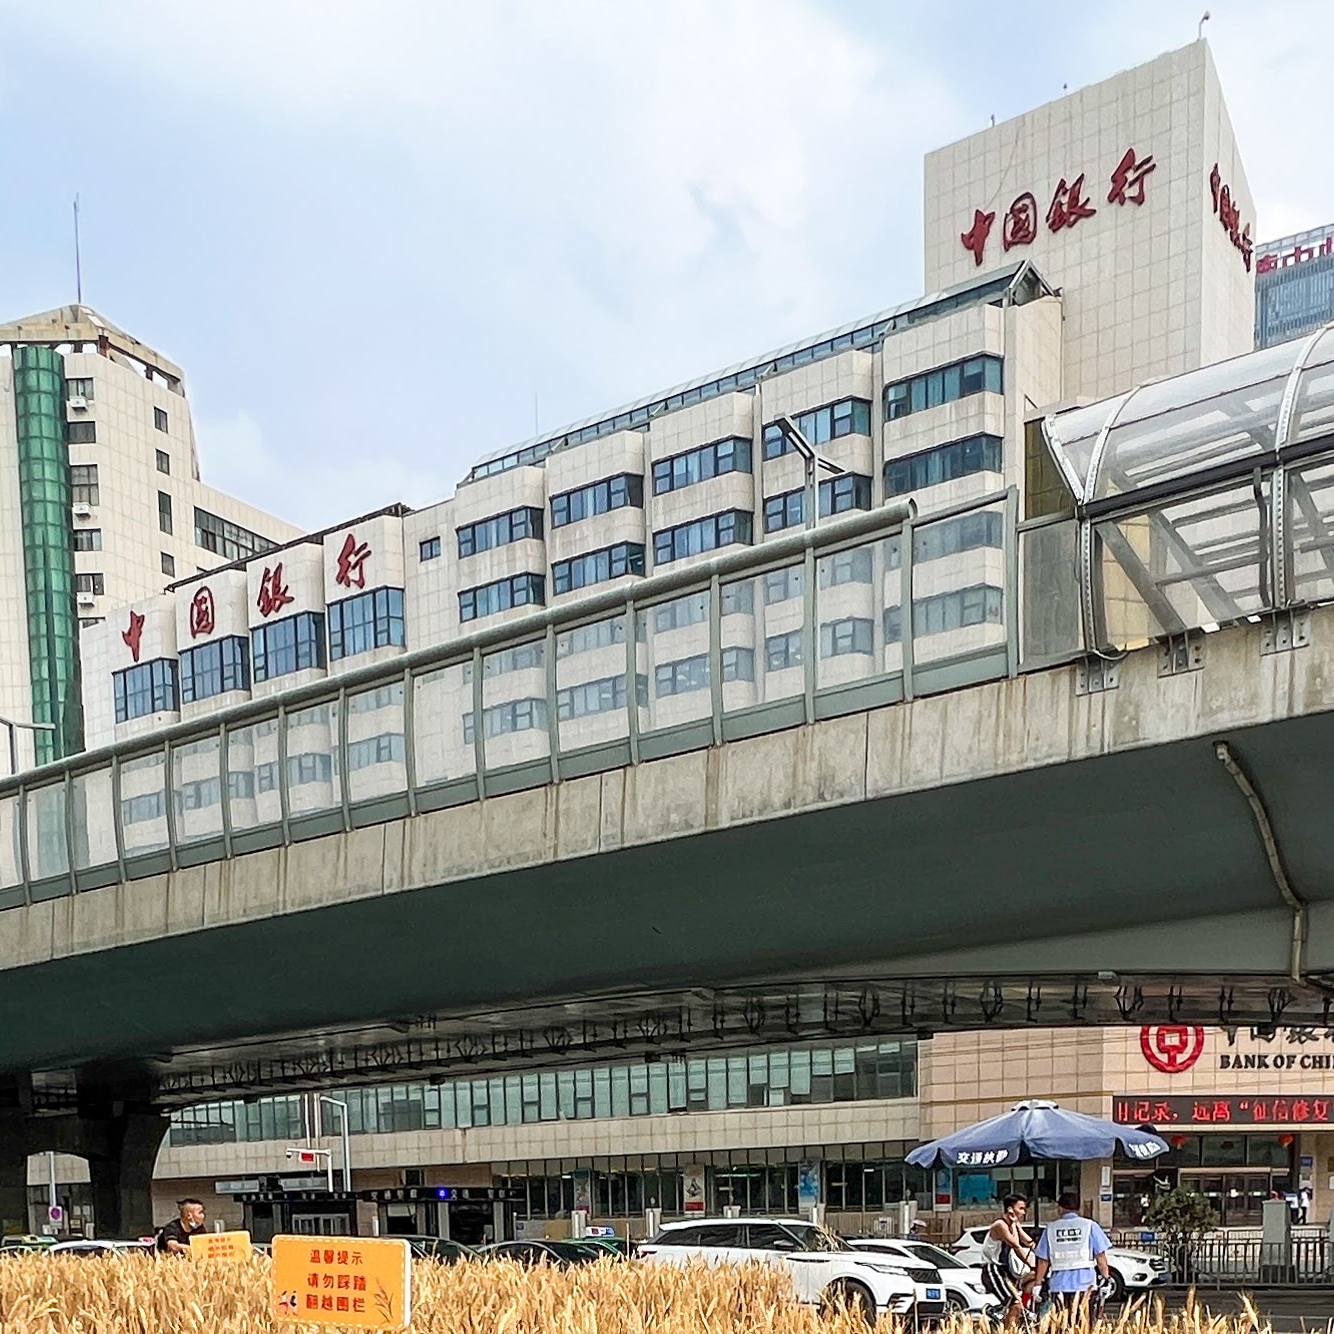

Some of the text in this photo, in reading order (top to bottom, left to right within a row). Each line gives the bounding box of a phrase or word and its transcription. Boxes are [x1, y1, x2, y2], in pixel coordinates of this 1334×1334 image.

[961, 147, 1157, 267] 中国银行
[122, 533, 372, 662] 中国银行
[1220, 1054, 1270, 1069] BANK
[1272, 1054, 1297, 1069] OF
[310, 1249, 363, 1266] 温馨提示
[307, 1273, 366, 1291] 请勿踩踏
[306, 1294, 366, 1313] 翻越围栏
